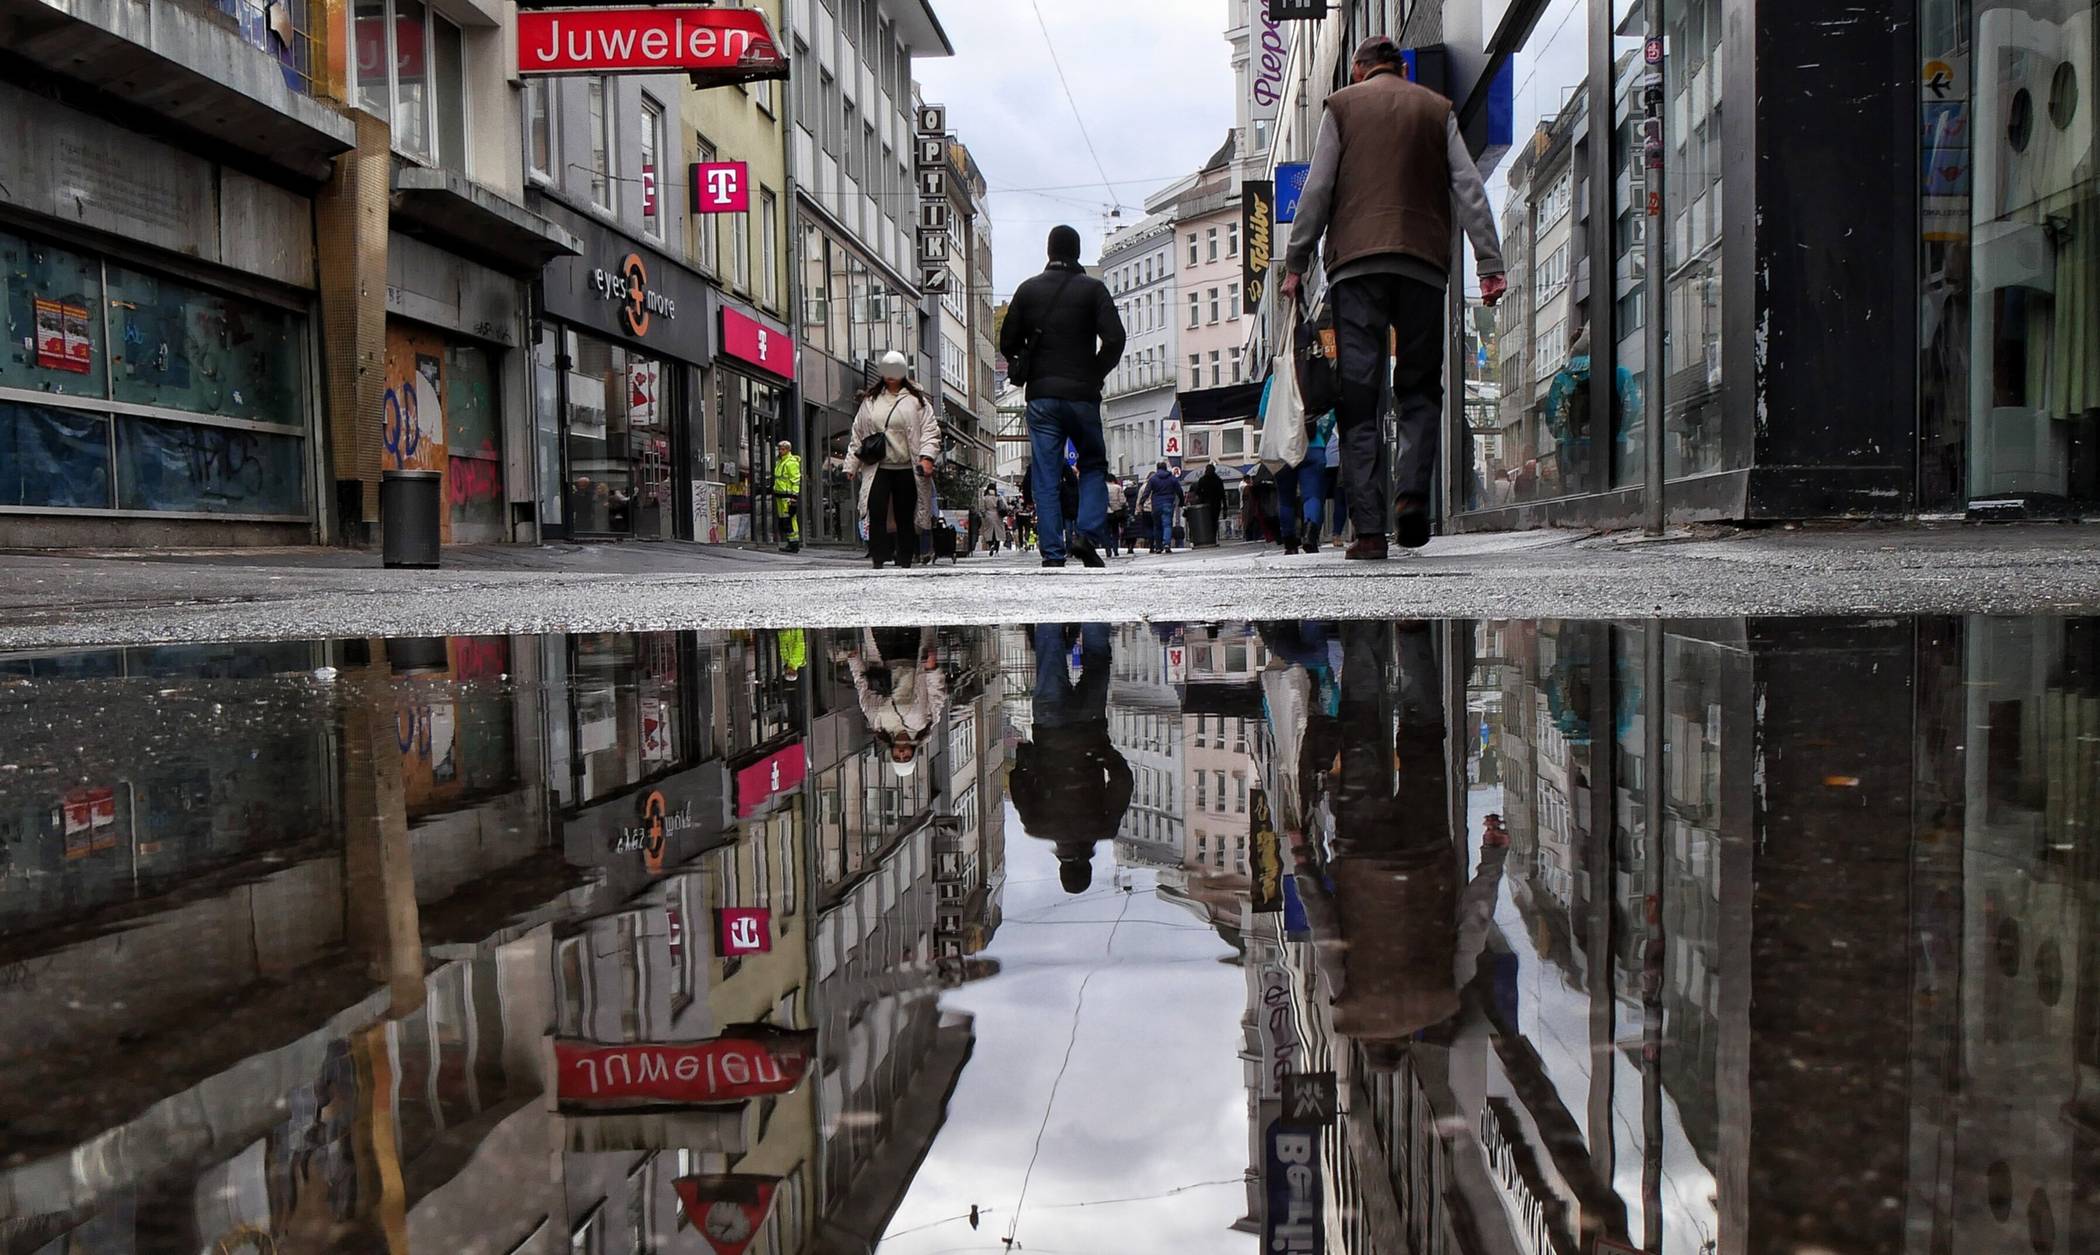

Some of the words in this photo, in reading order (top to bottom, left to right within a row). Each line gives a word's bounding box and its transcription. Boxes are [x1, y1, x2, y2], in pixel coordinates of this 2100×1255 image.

[536, 18, 748, 63] Juwelen
[707, 168, 738, 205] T
[923, 110, 944, 259] OPTIK
[1286, 199, 1297, 215] A
[1249, 191, 1271, 276] Tchibo
[595, 268, 626, 300] eyes
[647, 290, 675, 320] more
[757, 328, 768, 361] T
[1166, 437, 1179, 453] A
